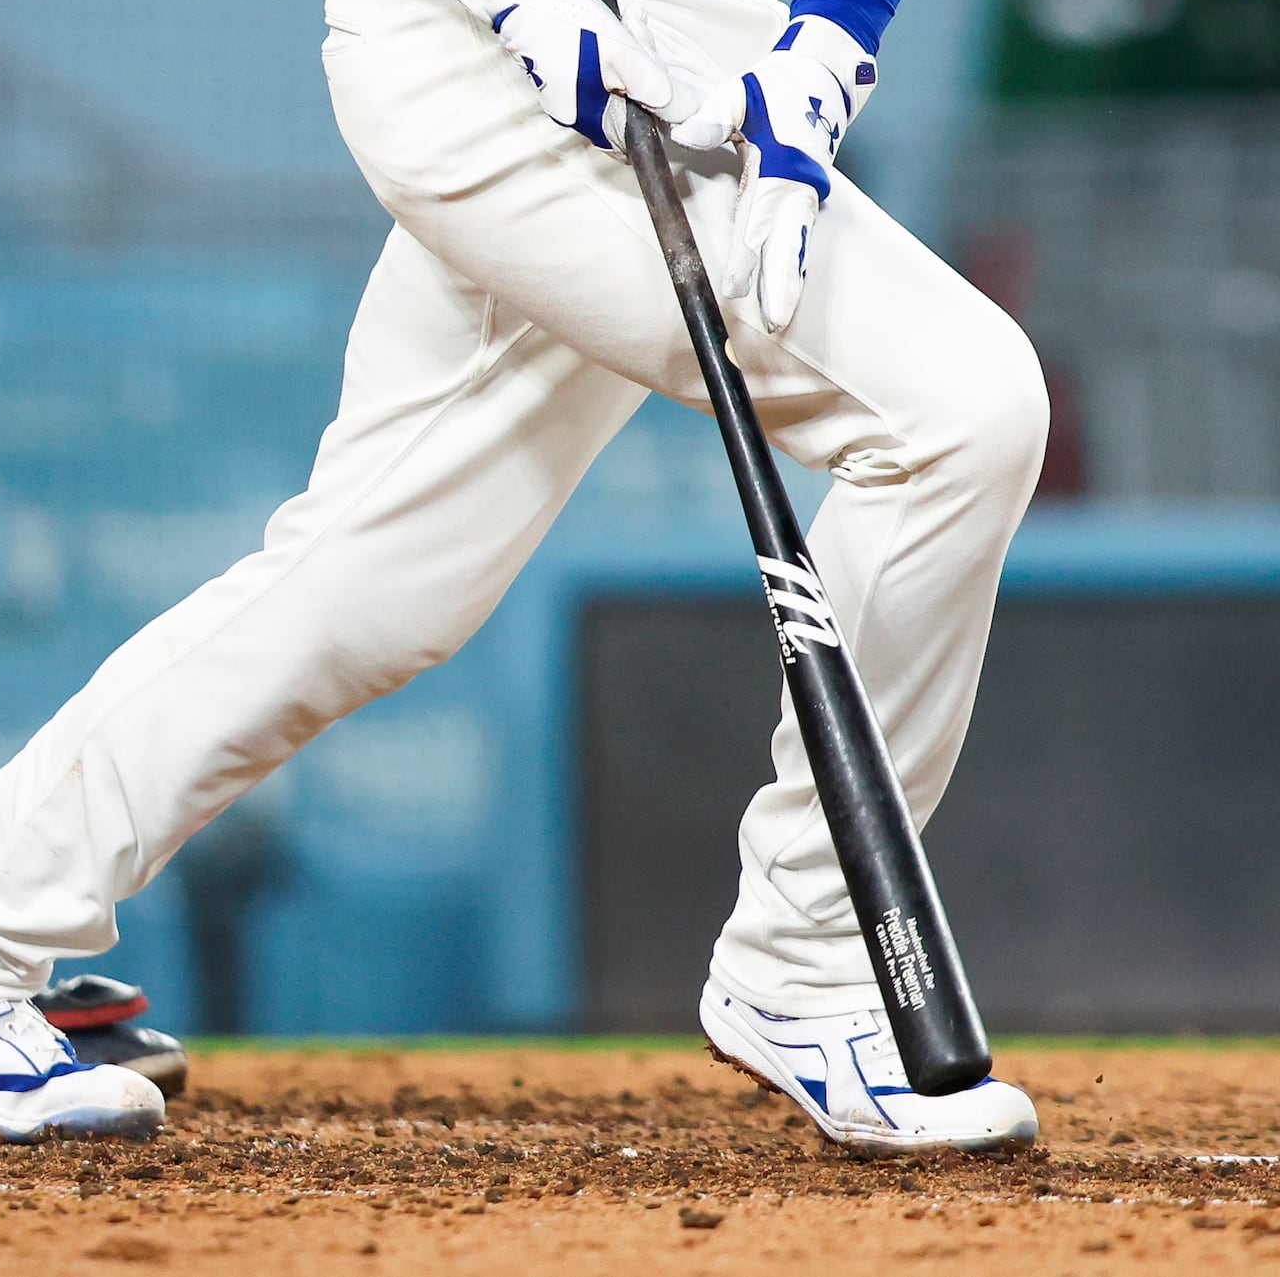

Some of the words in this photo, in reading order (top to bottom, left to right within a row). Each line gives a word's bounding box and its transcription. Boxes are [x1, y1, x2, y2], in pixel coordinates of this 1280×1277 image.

[761, 573, 797, 665] marucci
[882, 906, 911, 957] Freddie
[898, 953, 926, 1012] Freeman
[886, 958, 897, 978] Pro
[906, 916, 932, 974] Handcrafted
[923, 971, 935, 990] For
[891, 976, 910, 1009] Model
